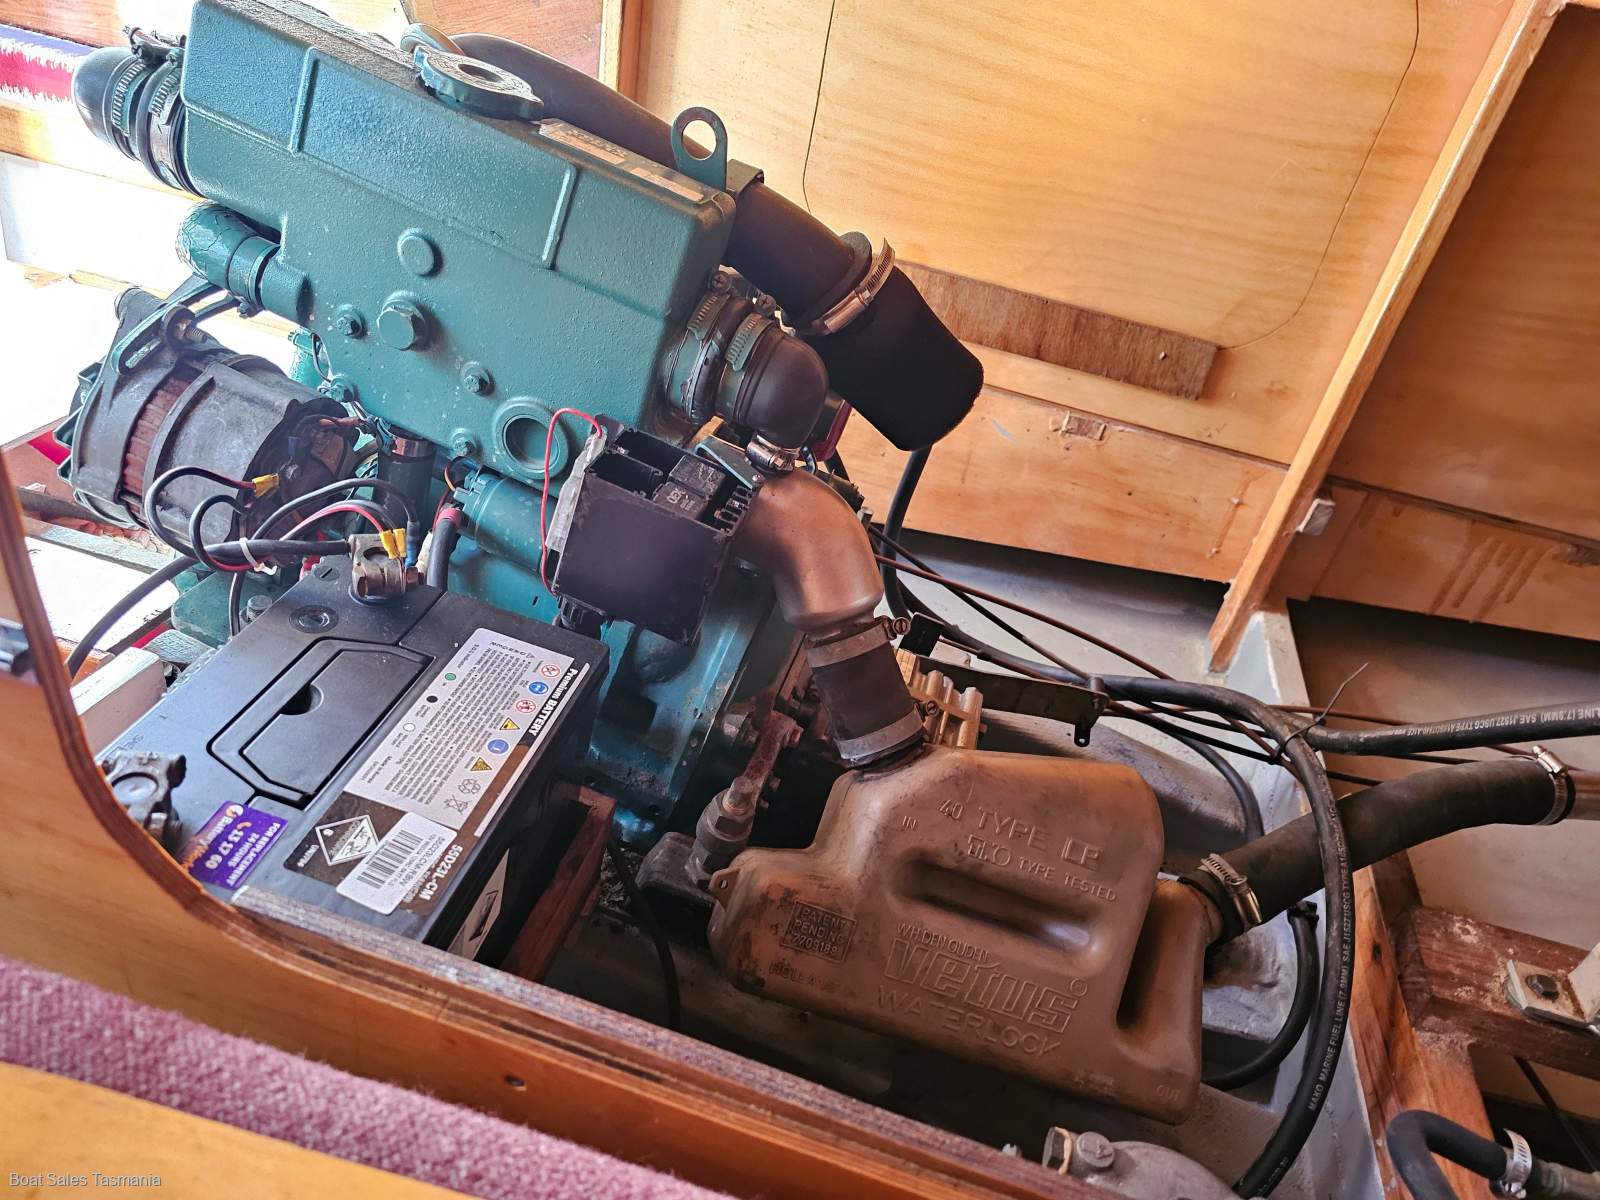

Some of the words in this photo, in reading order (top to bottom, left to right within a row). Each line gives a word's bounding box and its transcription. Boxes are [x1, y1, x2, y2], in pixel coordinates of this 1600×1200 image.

[550, 667, 579, 700] Premium
[526, 699, 558, 736] BATTERY
[1474, 718, 1495, 730] USCG
[1519, 713, 1536, 723] SAE
[1577, 708, 1600, 720] LINE
[227, 828, 245, 842] 13
[263, 822, 280, 837] FOR
[902, 815, 919, 832] IN
[938, 799, 964, 820] 40
[978, 807, 1050, 851] TYPE
[218, 840, 234, 855] 17
[248, 832, 260, 843] 24
[205, 854, 223, 869] 60
[226, 836, 263, 886] REPLACEMENT
[227, 841, 251, 867] HOURS
[416, 843, 464, 901] 55D23L-CM
[1018, 856, 1055, 880] TYPE
[1064, 872, 1117, 902] TESTED
[1343, 893, 1351, 917] USCG
[802, 906, 846, 929] PATENT
[793, 919, 845, 945] PENDING
[1342, 946, 1350, 962] SAE
[877, 984, 1062, 1058] WATERLOCK
[1334, 1002, 1345, 1023] LINE
[1329, 1024, 1342, 1046] FUEL
[1319, 1049, 1336, 1082] MARINE
[1308, 1082, 1324, 1110] MAKO
